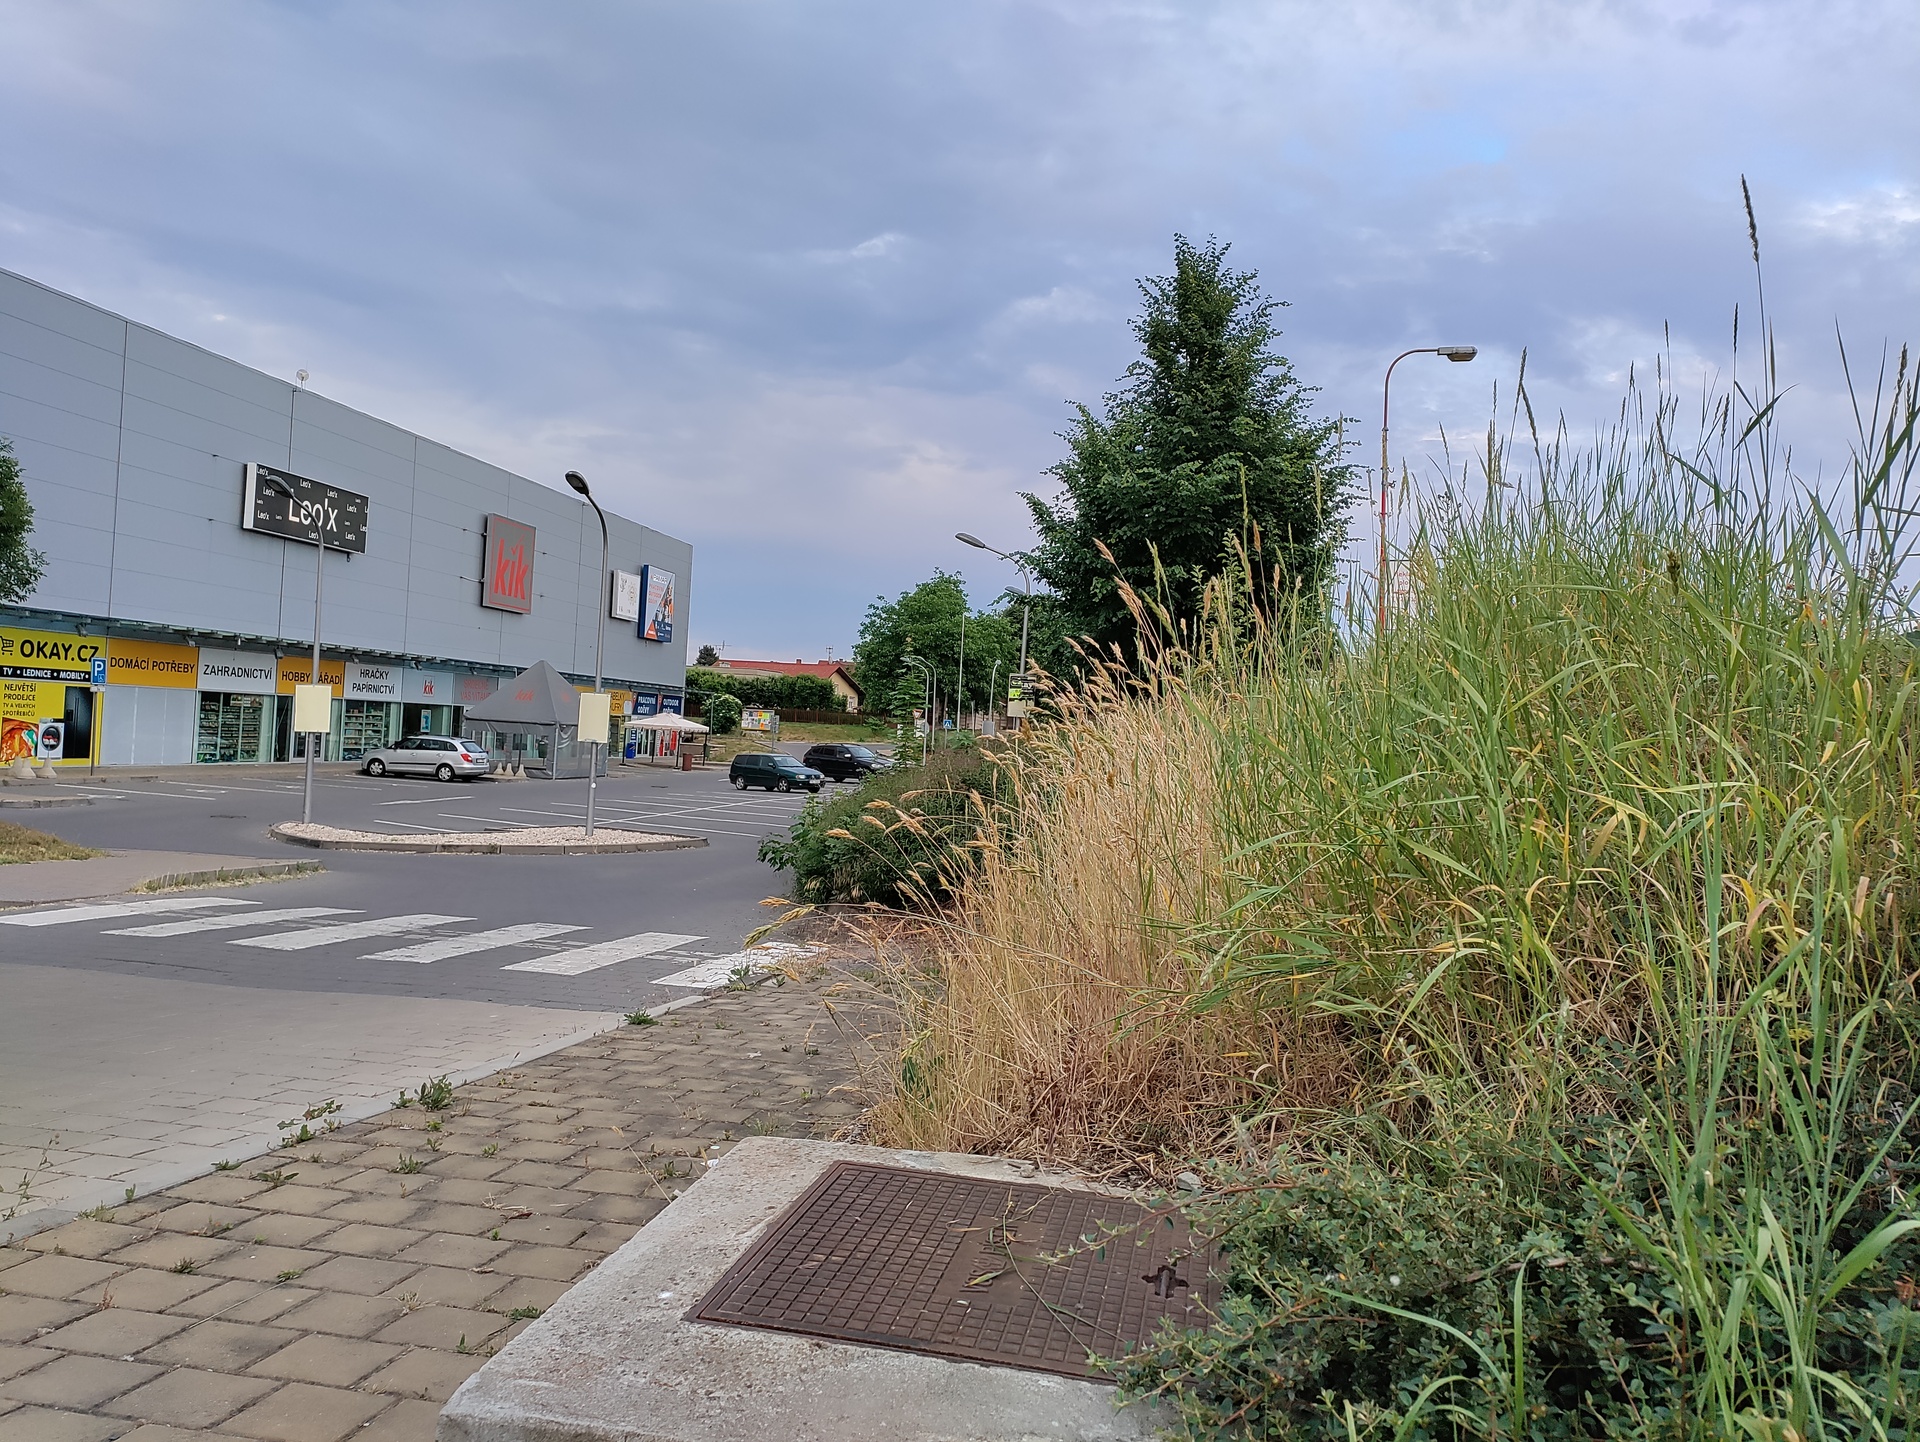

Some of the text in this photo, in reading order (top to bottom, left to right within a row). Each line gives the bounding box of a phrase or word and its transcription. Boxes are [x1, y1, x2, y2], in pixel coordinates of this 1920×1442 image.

[288, 488, 338, 532] Leo'x
[494, 536, 529, 600] kik
[20, 640, 99, 662] OKAY.CZ
[95, 661, 103, 676] P
[110, 657, 195, 674] DOMÁCÍ POTŘEBY
[203, 664, 272, 680] ZAHRADNICTVÍ
[3, 667, 85, 680] TV LEDNICE MOBILY
[282, 671, 342, 685] HOBBY ÁŘADÍ
[360, 668, 389, 680] HRAČKY
[4, 683, 36, 692] NEJVĚTŠÍ
[352, 682, 395, 694] PAPÍRNICTVÍ
